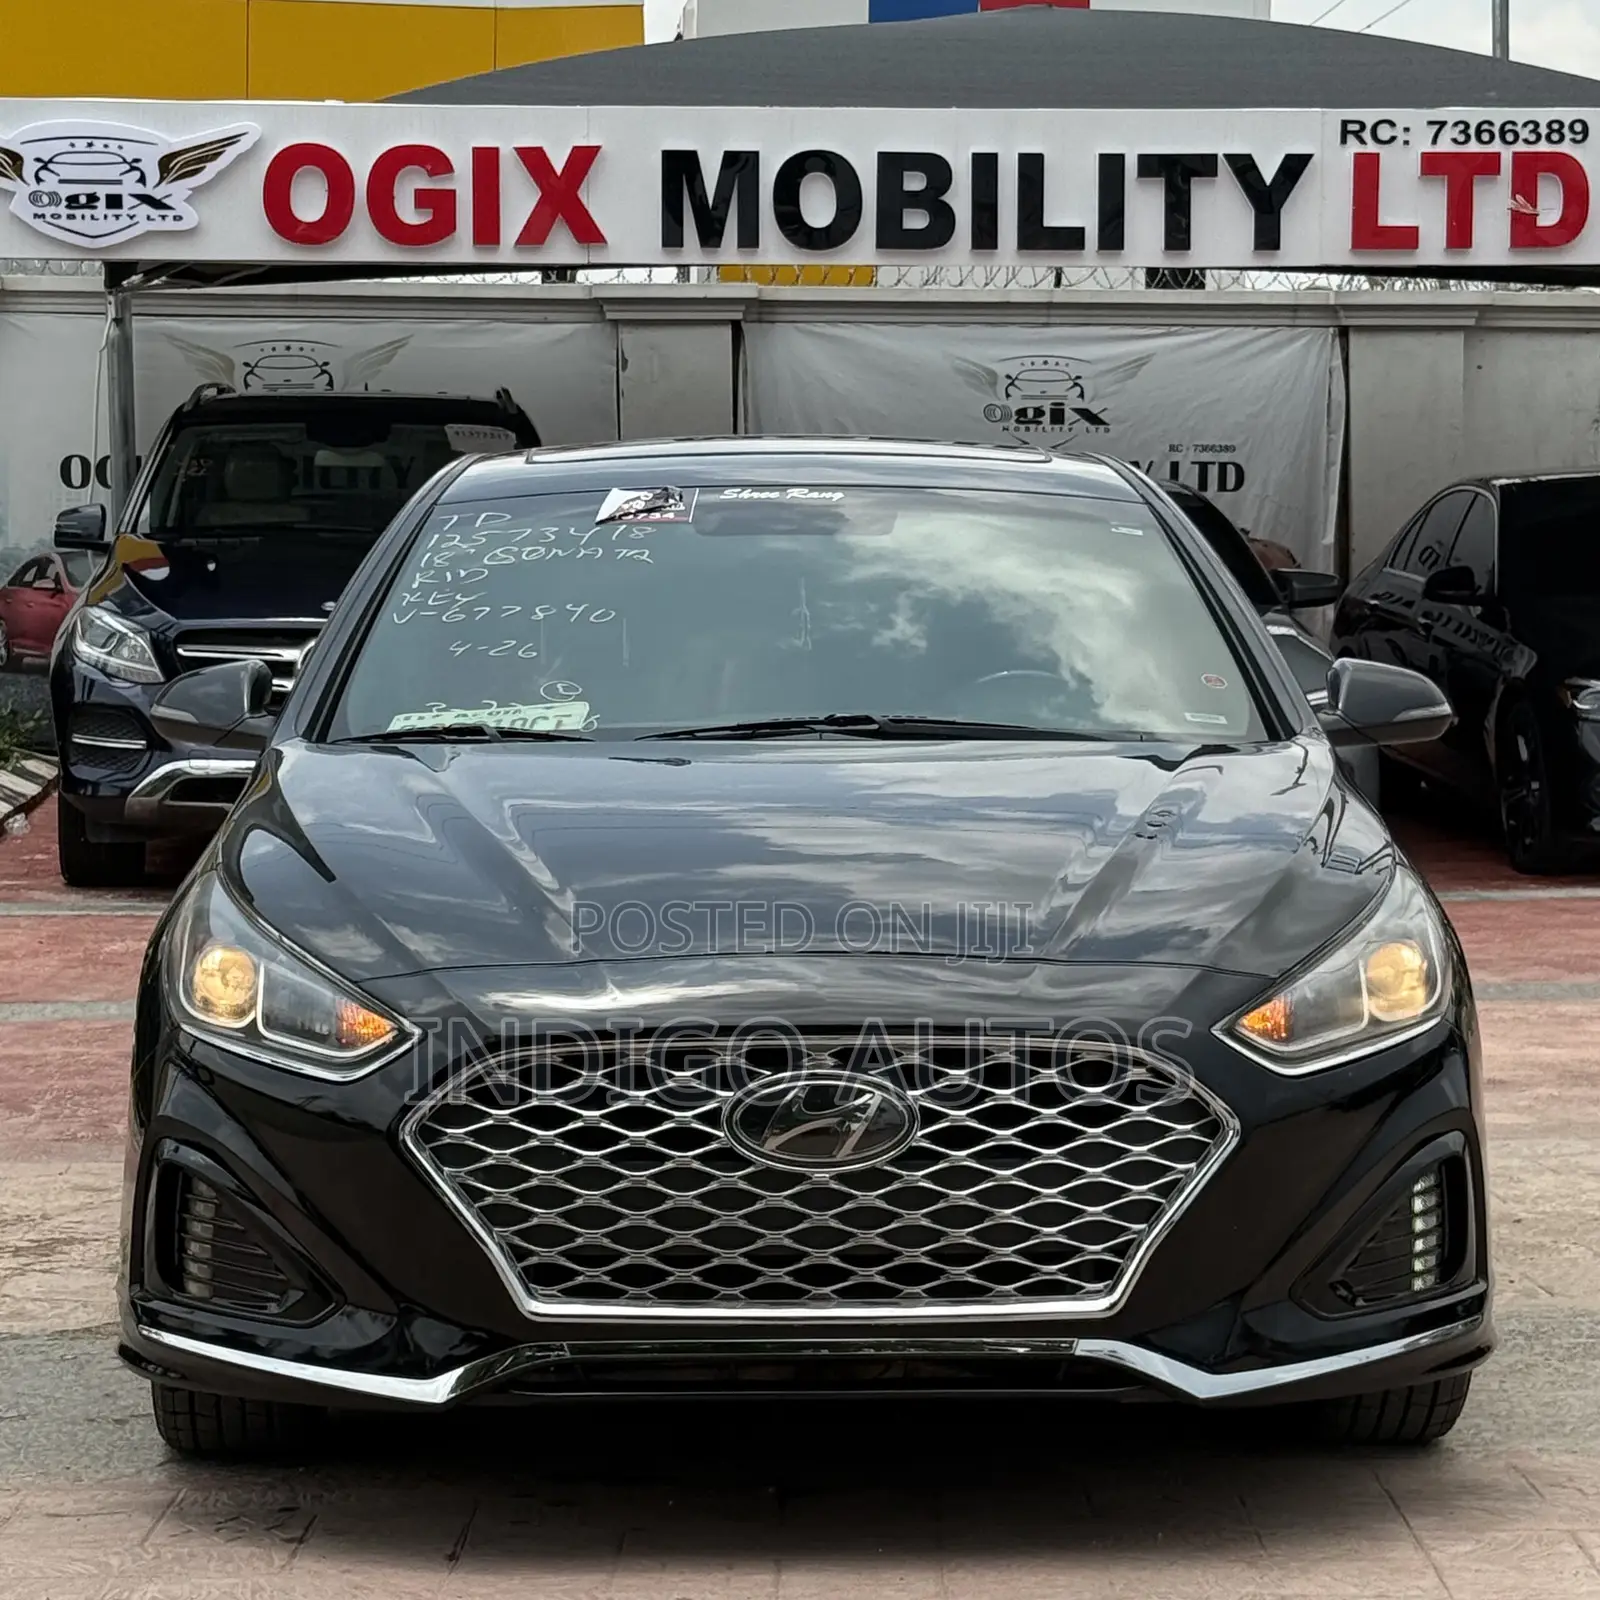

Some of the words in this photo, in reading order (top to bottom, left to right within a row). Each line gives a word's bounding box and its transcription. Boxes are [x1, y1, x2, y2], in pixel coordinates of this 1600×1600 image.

[1339, 118, 1411, 146] RC:
[1426, 119, 1590, 146] 7366389
[262, 142, 608, 247] OGIX
[661, 149, 1315, 253] MOBILITY
[1350, 151, 1591, 251] LTD
[33, 212, 136, 221] MOBILITY
[146, 214, 184, 222] LTD
[449, 640, 538, 659] 4-26
